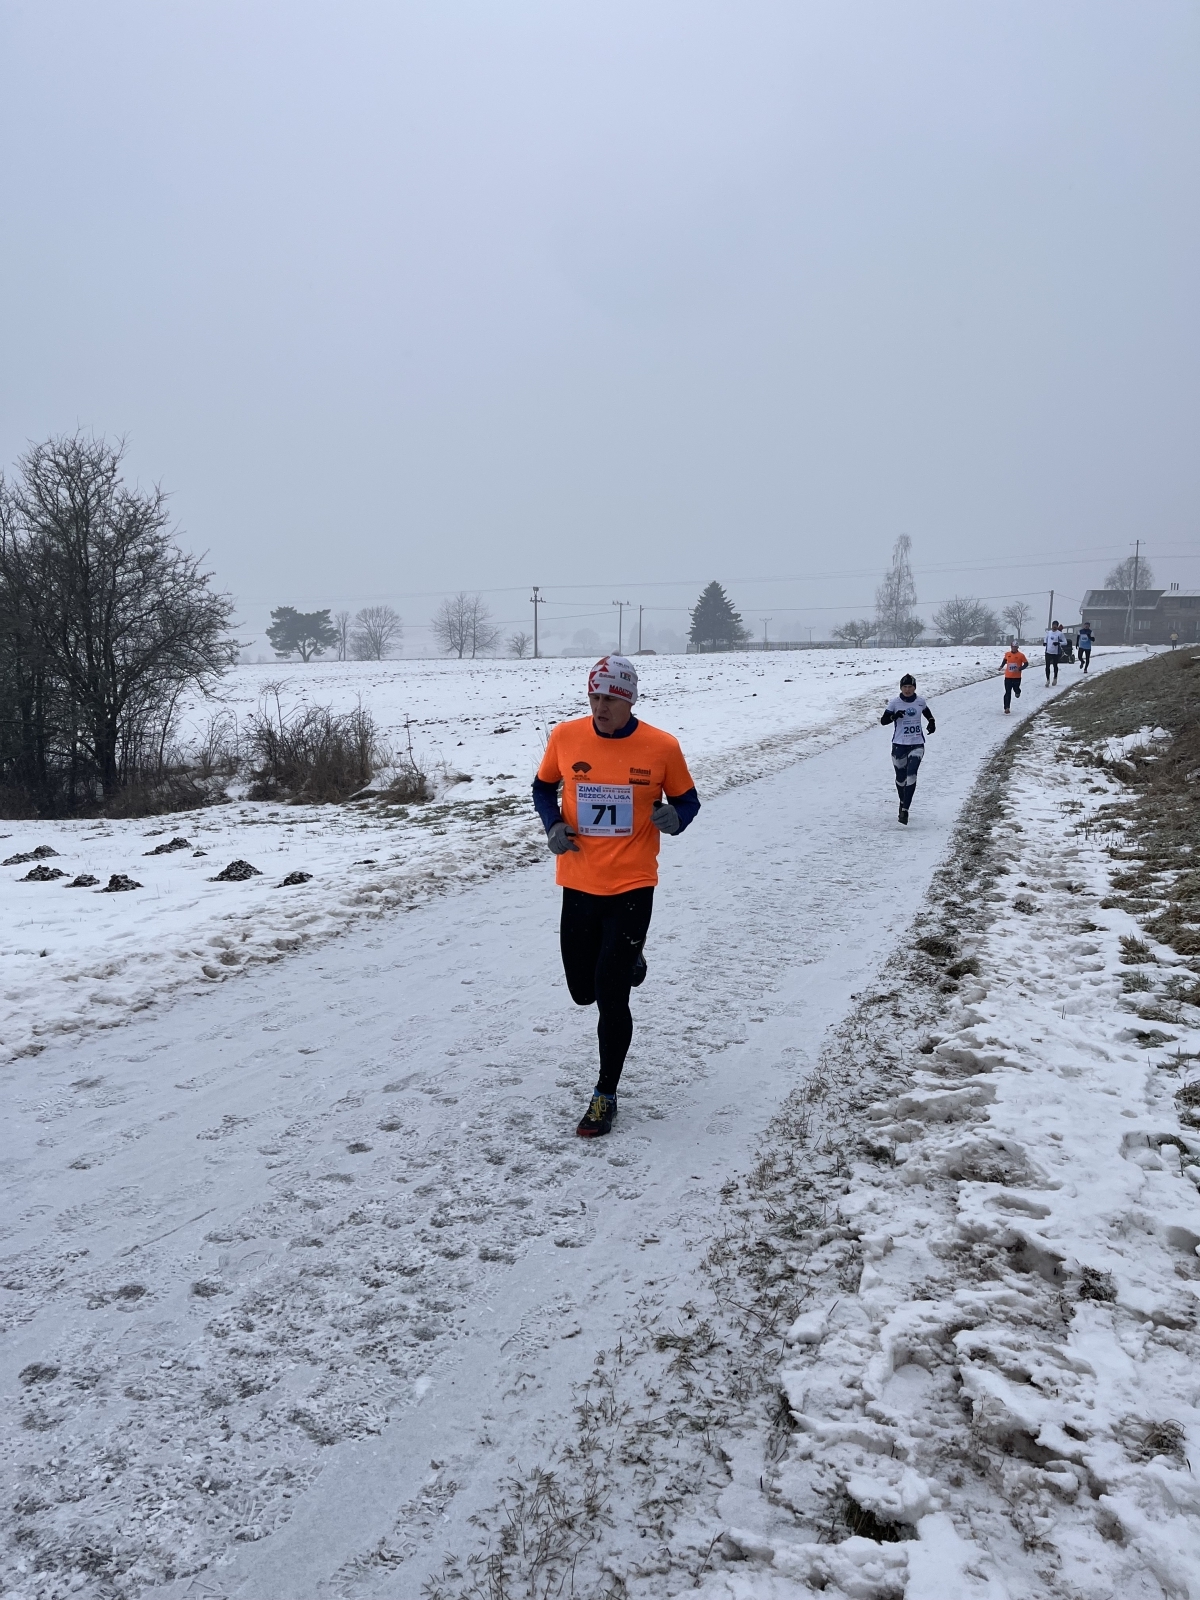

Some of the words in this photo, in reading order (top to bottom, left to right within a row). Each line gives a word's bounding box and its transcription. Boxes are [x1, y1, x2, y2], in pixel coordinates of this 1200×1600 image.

[904, 725, 920, 734] 208
[579, 785, 601, 793] ZIMNÍ
[591, 804, 617, 825] 71
